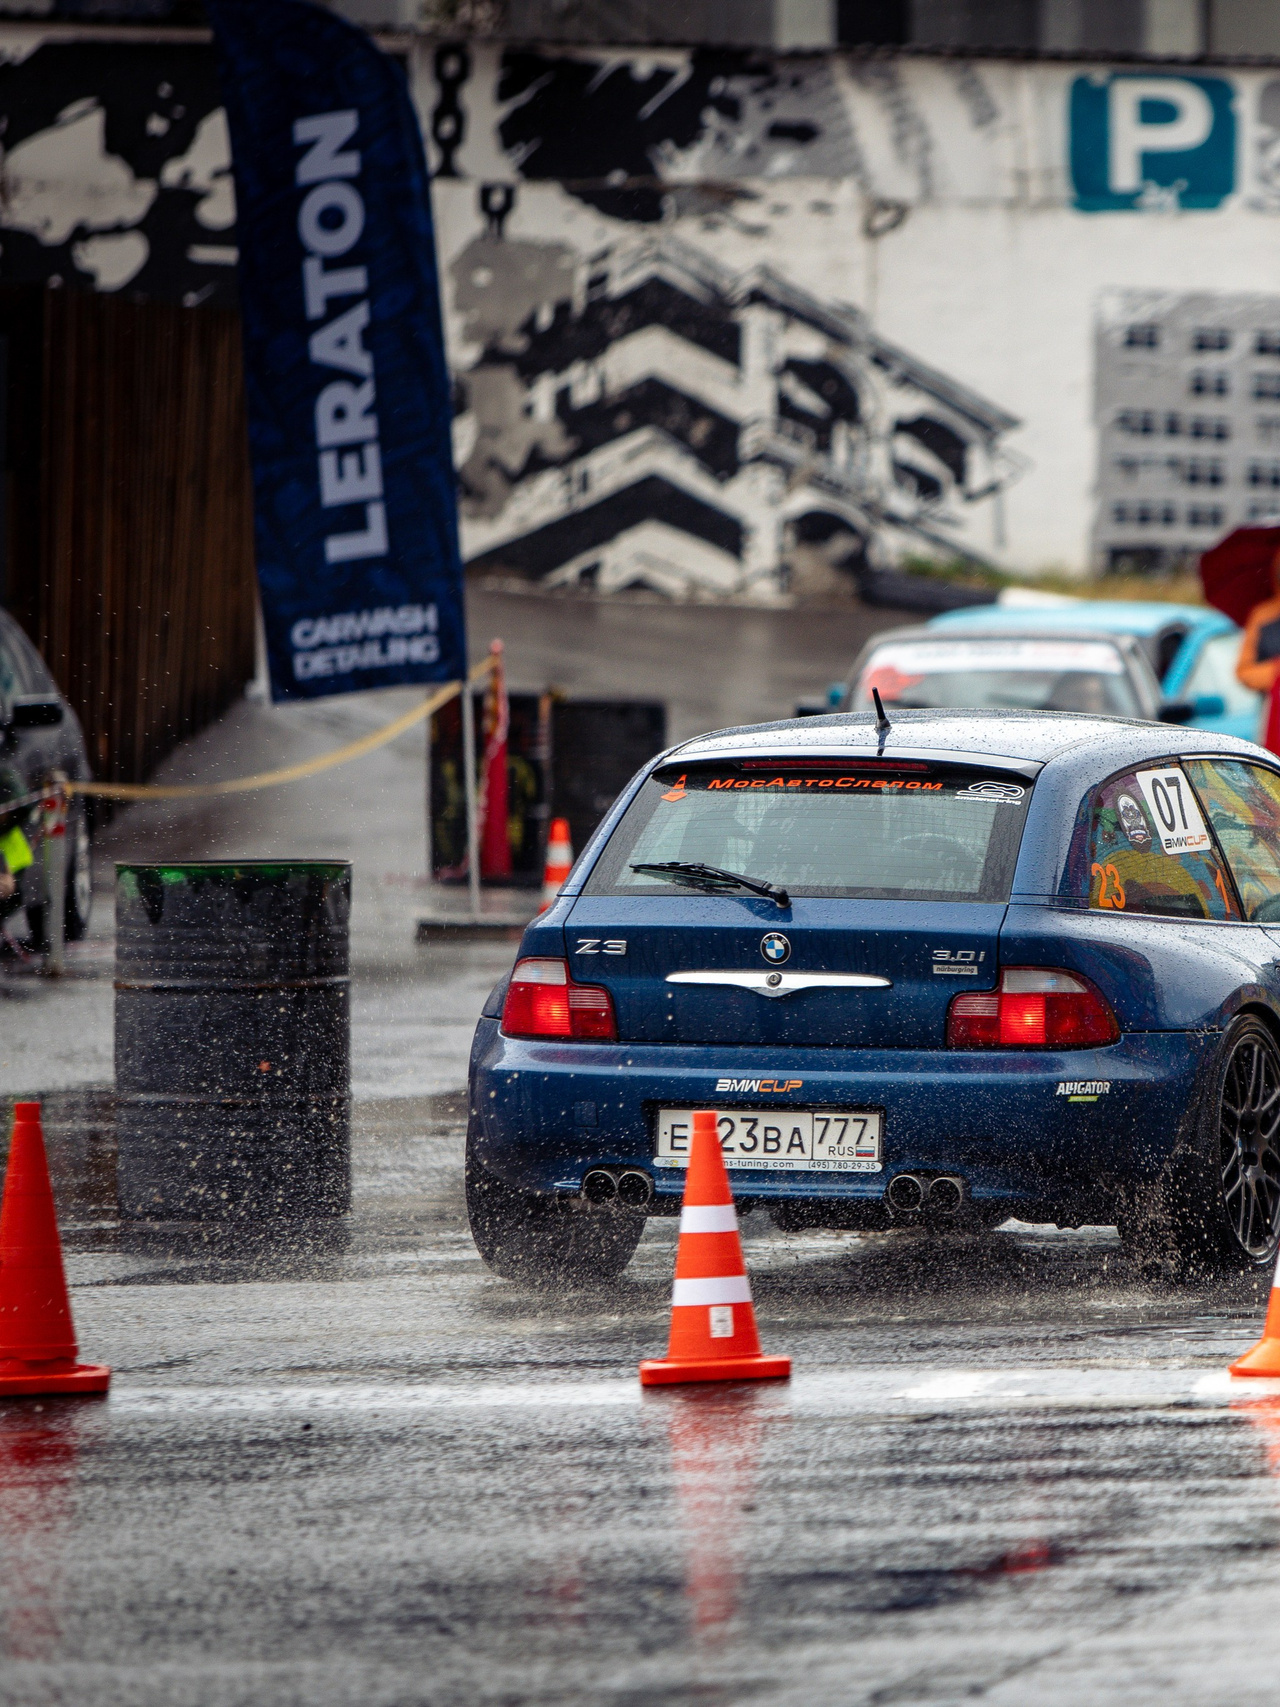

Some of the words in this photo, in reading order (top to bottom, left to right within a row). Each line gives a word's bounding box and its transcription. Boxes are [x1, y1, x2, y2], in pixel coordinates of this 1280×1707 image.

[1108, 78, 1214, 193] P
[292, 108, 389, 564] LERATON
[291, 603, 438, 649] CARWASH
[293, 635, 440, 681] DETAILING
[1151, 776, 1188, 832] 07
[1091, 862, 1126, 909] 23
[575, 939, 627, 956] Z3
[815, 1117, 868, 1145] 777
[828, 1146, 854, 1156] RUS
[808, 1161, 830, 1170] (495)
[832, 1161, 877, 1171] 780-29-35
